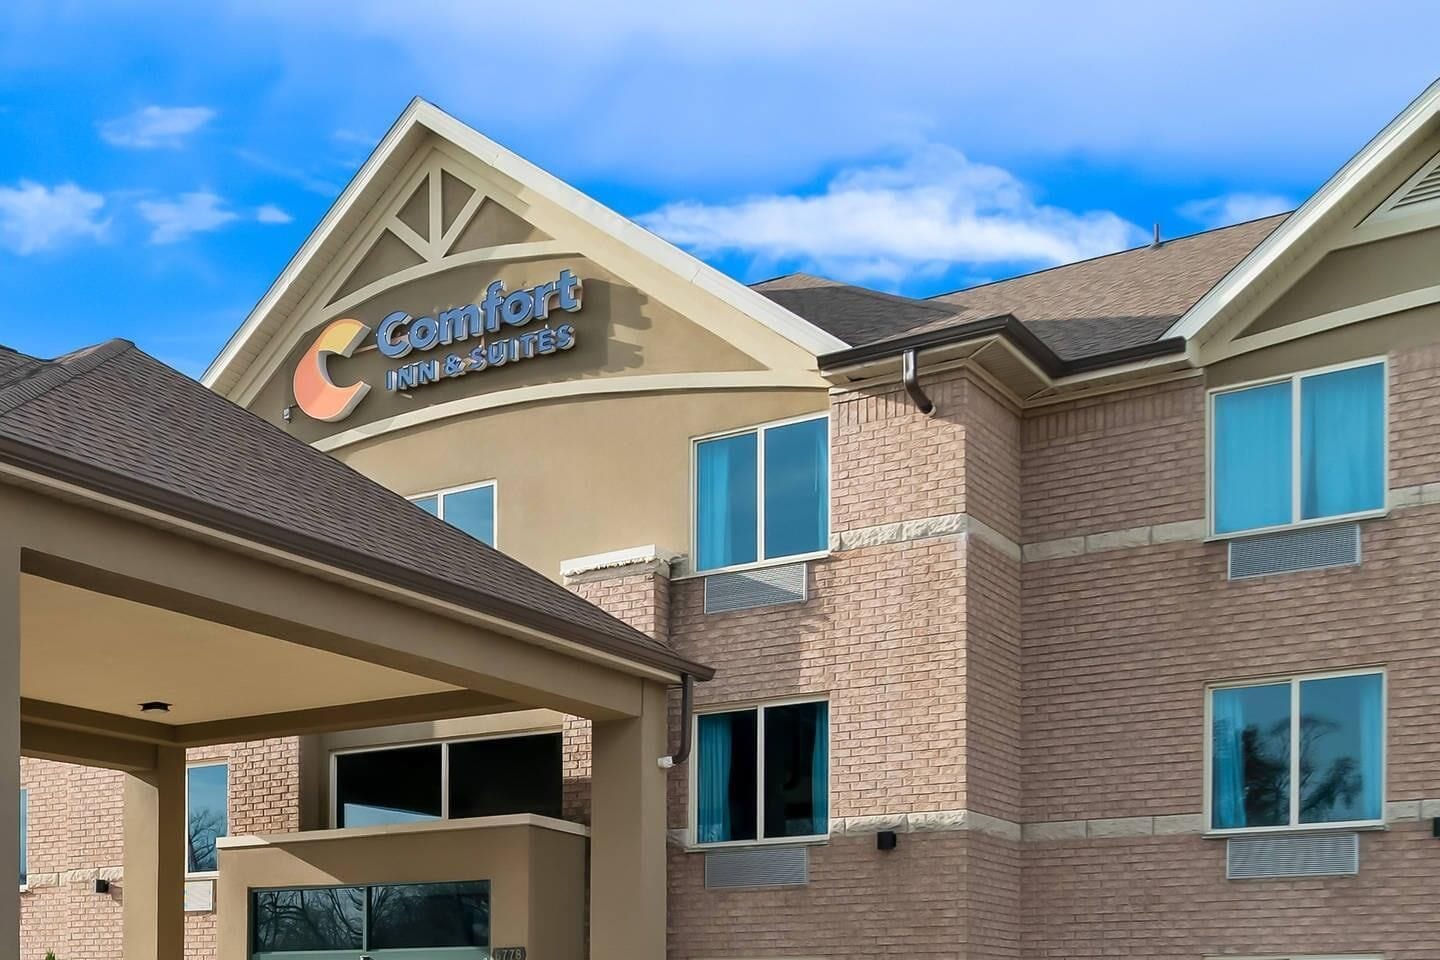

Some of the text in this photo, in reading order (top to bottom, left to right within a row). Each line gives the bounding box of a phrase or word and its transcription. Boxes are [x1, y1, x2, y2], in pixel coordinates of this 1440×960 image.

[376, 268, 583, 359] Comfort
[386, 323, 576, 392] INN & SUITES
